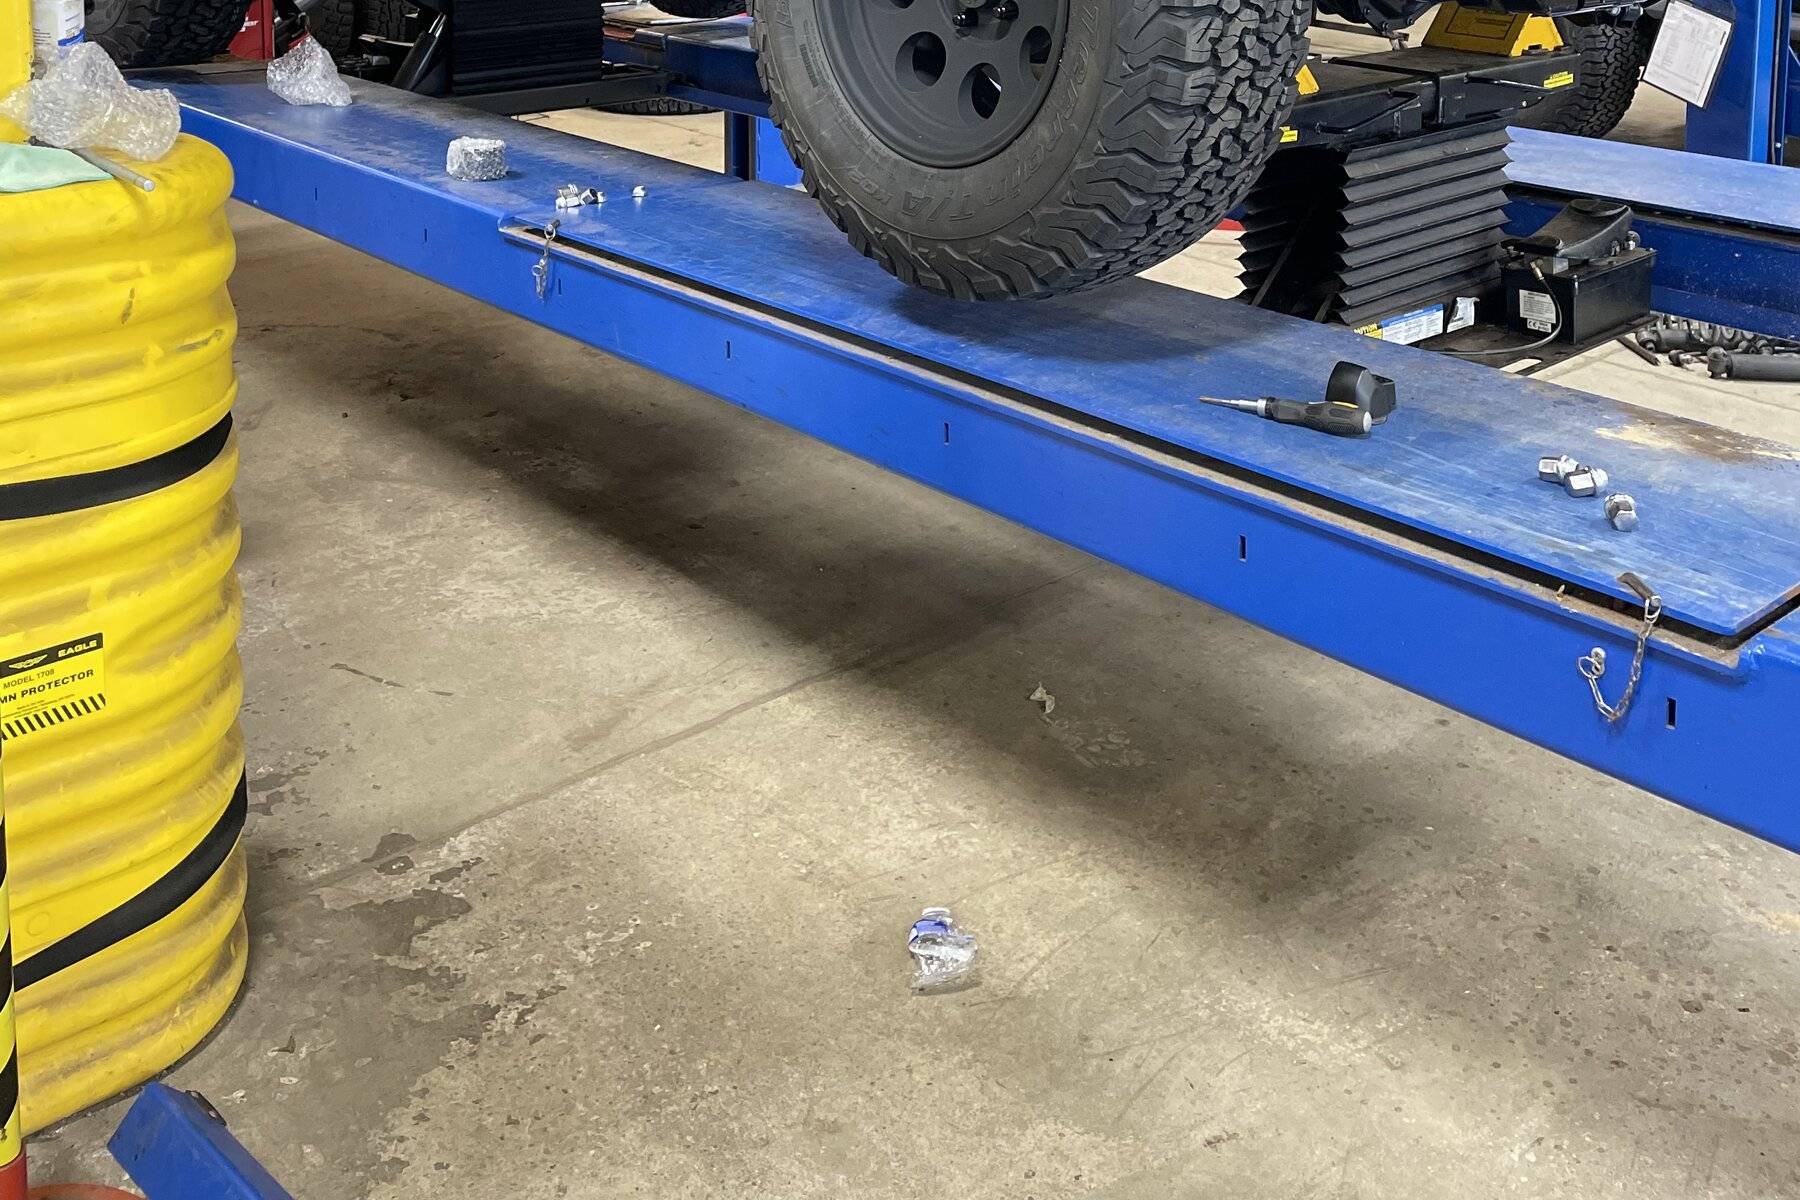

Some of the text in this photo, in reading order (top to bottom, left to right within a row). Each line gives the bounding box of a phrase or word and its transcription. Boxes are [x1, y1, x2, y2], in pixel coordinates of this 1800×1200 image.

[58, 639, 97, 657] EAGLE
[3, 675, 34, 689] MODEL
[21, 669, 94, 698] PROTECTOR
